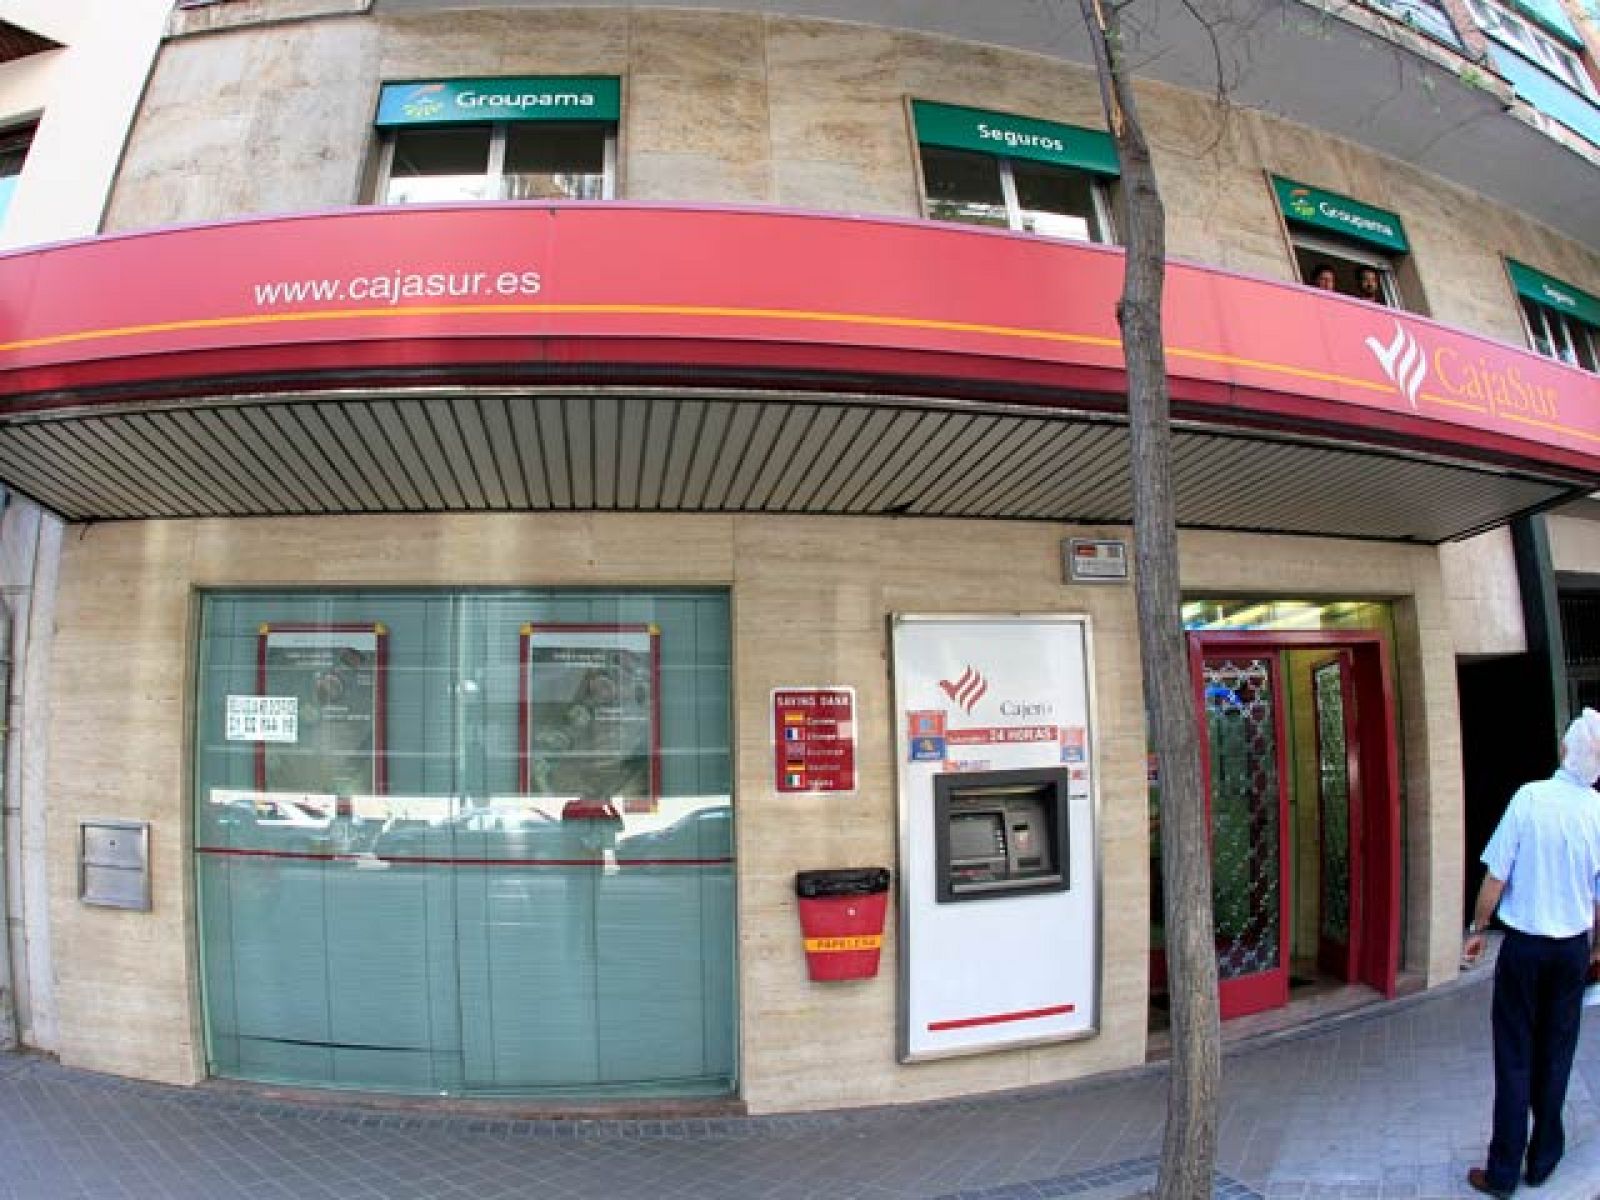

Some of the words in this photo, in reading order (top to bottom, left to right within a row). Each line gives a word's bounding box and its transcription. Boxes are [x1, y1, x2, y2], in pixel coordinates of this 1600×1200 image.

[456, 91, 595, 110] Groupama
[977, 122, 1064, 151] Seguros
[1319, 202, 1393, 236] Groupama
[254, 269, 541, 305] www.cajasur.es
[1434, 347, 1558, 418] CajaSur
